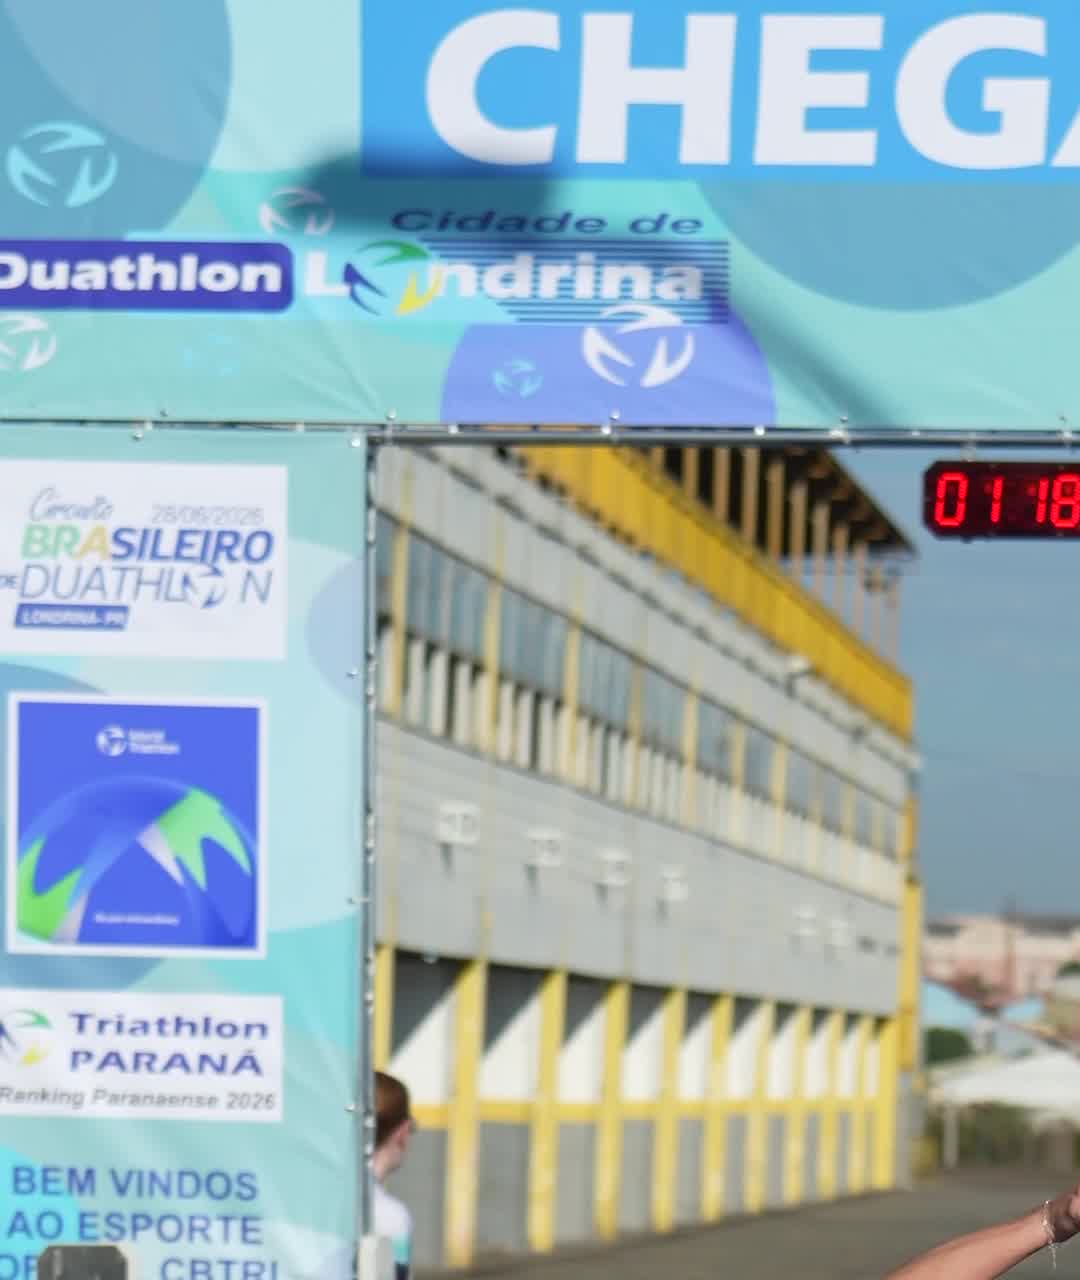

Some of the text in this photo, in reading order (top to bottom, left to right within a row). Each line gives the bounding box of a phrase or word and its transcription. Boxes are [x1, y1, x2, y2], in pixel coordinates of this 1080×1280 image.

[390, 208, 704, 236] Cidade de
[0, 250, 282, 293] Duathlon
[21, 523, 275, 564] BRASILEIRO
[68, 1010, 269, 1040] Triathlon
[70, 1049, 264, 1077] PARANÁ
[0, 1086, 276, 1110] Ranking Paranaense 2026
[11, 1166, 259, 1202] BEM VINDOS
[6, 1210, 265, 1245] AO ESPORTE
